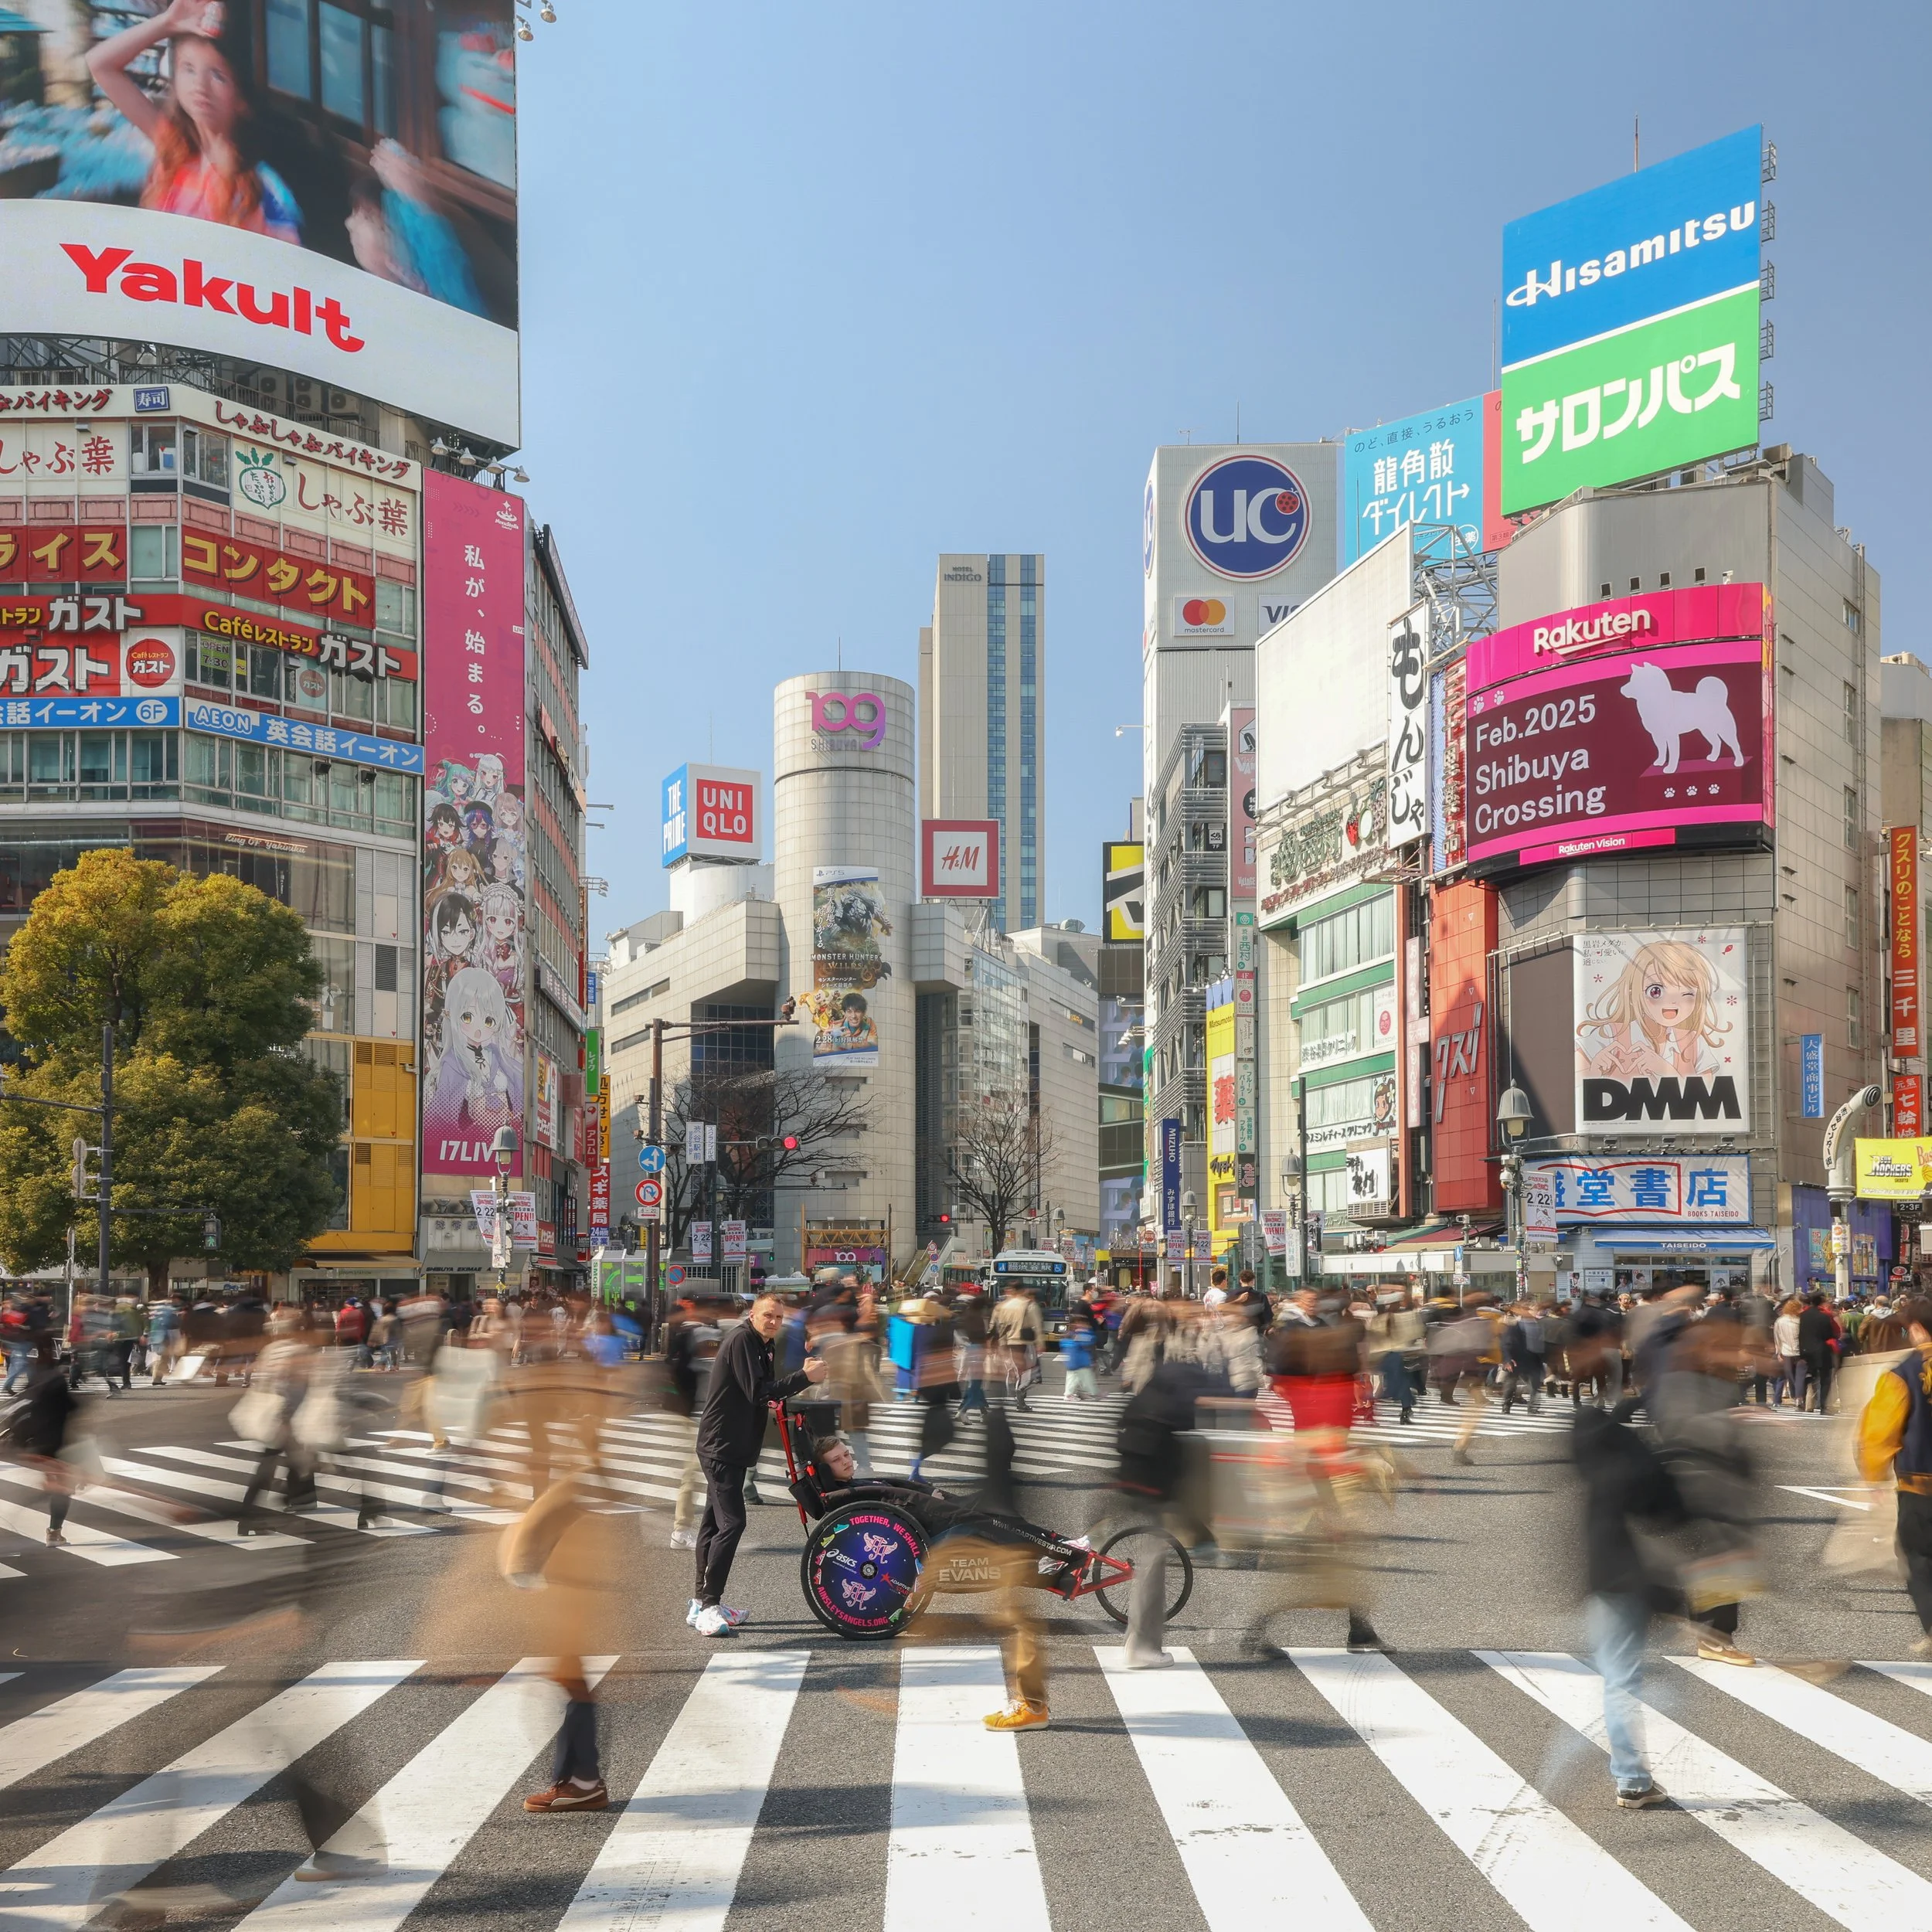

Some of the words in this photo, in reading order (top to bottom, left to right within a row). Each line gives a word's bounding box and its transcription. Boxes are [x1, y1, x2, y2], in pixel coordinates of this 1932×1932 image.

[1506, 201, 1755, 306] Hisamitsu
[60, 243, 366, 352] Yakult
[137, 391, 165, 407] 寿司
[1516, 343, 1740, 464] サロンパス
[215, 400, 411, 479] しゃぶしゃぶバイキング
[1354, 409, 1475, 453] のど、直接、うるおう
[1373, 438, 1454, 495] 龍角散
[298, 471, 409, 537] しゃぶ葉
[1200, 487, 1301, 544] UC
[1362, 480, 1470, 536] ダイレクト
[183, 535, 372, 612] コンタクト
[944, 573, 982, 582] INDIGO
[0, 607, 42, 624] トラン
[49, 596, 142, 631] ガスト
[1533, 609, 1651, 655] Rakuten
[319, 634, 401, 678] ガスト
[464, 544, 487, 734] 私が、始まる。
[0, 646, 109, 692] ガスト
[132, 660, 171, 674] ガスト
[140, 704, 164, 720] 6F
[195, 705, 252, 733] AEON
[806, 691, 886, 750] 109
[1392, 617, 1425, 832] もんじゃ
[1475, 694, 1597, 753] Feb.2025
[266, 719, 419, 766] 英会話イーオン
[1475, 748, 1590, 795] Shibuya
[667, 779, 682, 818] THE
[702, 787, 743, 811] UNI
[1475, 786, 1607, 834] Crossing
[663, 811, 685, 855] PRIME
[702, 811, 747, 835] QLO
[941, 845, 981, 871] H&M
[1558, 840, 1595, 855] Rakuten
[1597, 837, 1626, 849] Vision
[1895, 832, 1913, 958] クスリのことなら
[849, 952, 879, 961] HUNTER
[1893, 968, 1917, 1046] 三千里
[588, 1051, 597, 1072] レイク
[1804, 1039, 1820, 1114] 大盛堂商事ビル
[1582, 1075, 1743, 1121] DMM
[587, 1129, 596, 1155] アコム
[1168, 1128, 1176, 1163] MIZUHO
[592, 1165, 609, 1225] スギ薬局
[1167, 1188, 1175, 1226] みずほ銀行
[591, 1237, 609, 1246] 営業
[1264, 1226, 1284, 1235] OPEN!!
[849, 1515, 890, 1528] TOGETHER,
[893, 1522, 905, 1536] WE
[902, 1532, 920, 1558] SHALL
[992, 1519, 1073, 1557] WWW.ADAPTIVESTAR.COM
[835, 1553, 858, 1568] asics
[938, 1566, 1002, 1583] EVANS
[950, 1556, 989, 1568] TEAM
[817, 1586, 889, 1628] AINSLEYSANGELS.ORG
[889, 1579, 911, 1591] ADAPTIVE
